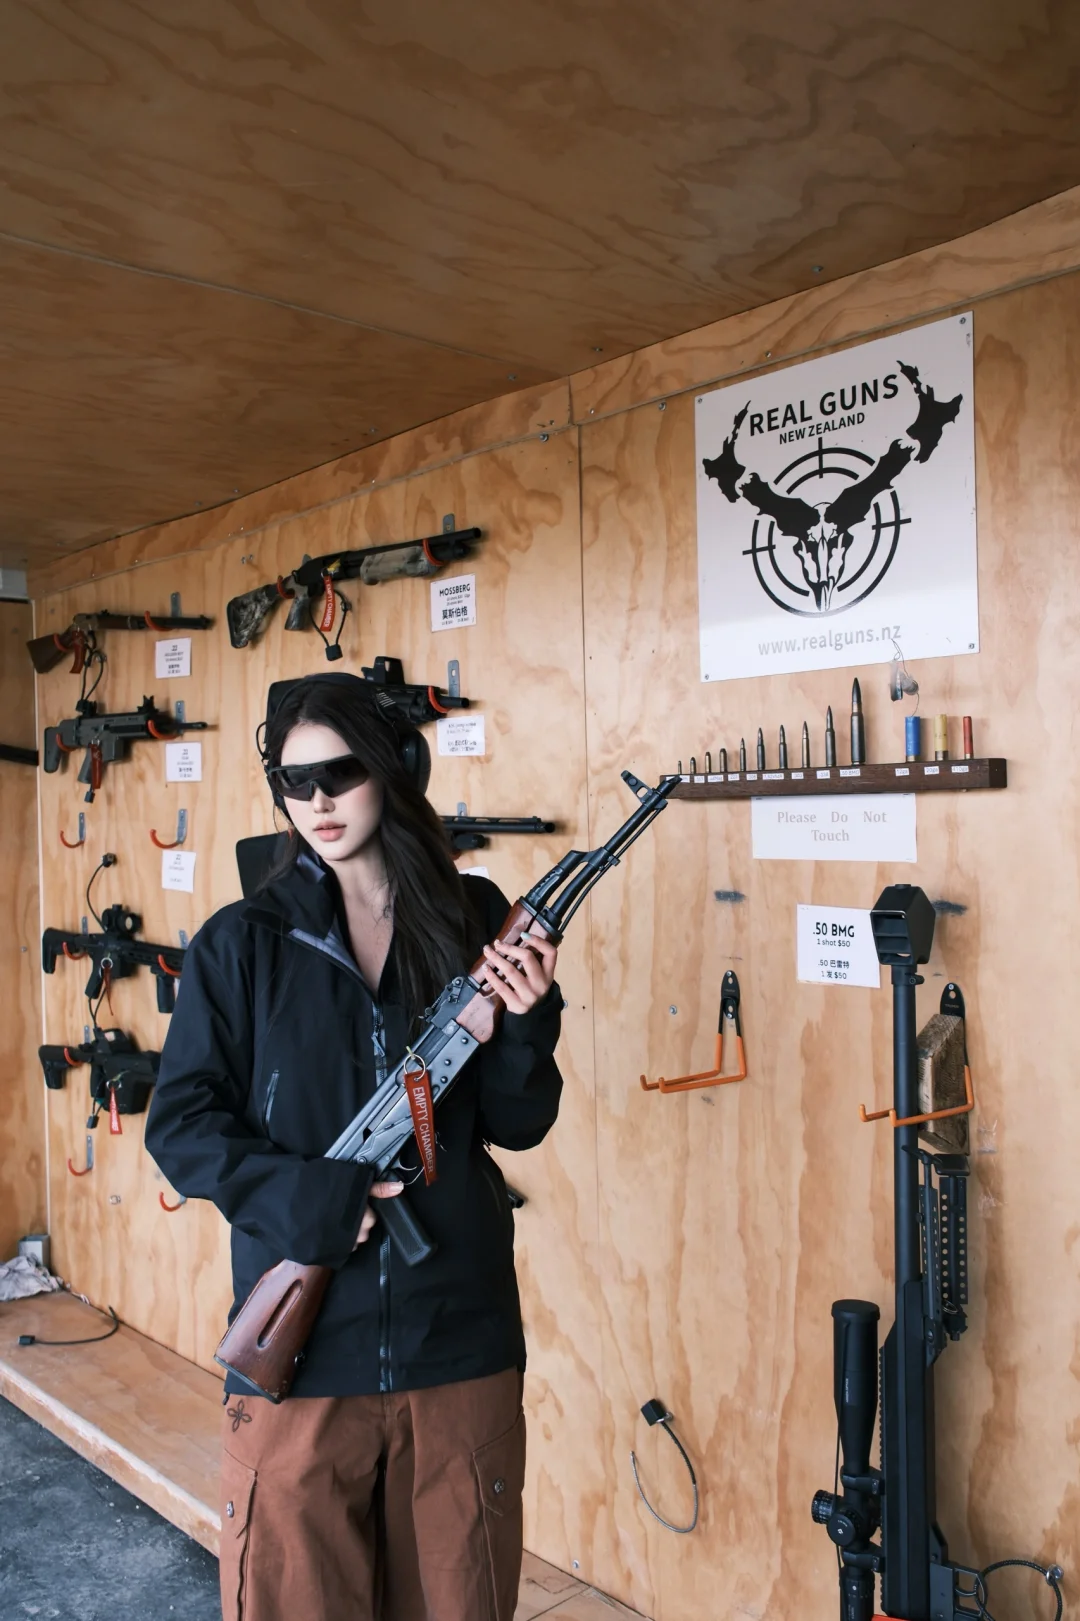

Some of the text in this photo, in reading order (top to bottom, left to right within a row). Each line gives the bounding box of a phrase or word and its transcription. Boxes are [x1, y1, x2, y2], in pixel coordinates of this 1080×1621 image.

[750, 374, 899, 436] REAL GUNS
[779, 412, 865, 445] NEW ZEALAND
[439, 583, 471, 597] MOSSBERG
[442, 605, 468, 620] 莫斯伯格
[758, 625, 902, 656] www.realguns.nz
[777, 811, 887, 823] Please Do Not
[811, 829, 850, 842] Touch
[813, 922, 855, 938] .50 BMG
[822, 938, 836, 947] shot
[838, 939, 851, 948] $50
[818, 959, 850, 969] .50 巴雷特
[834, 971, 847, 980] $50
[413, 1086, 434, 1173] EMPTY CHAMBER
